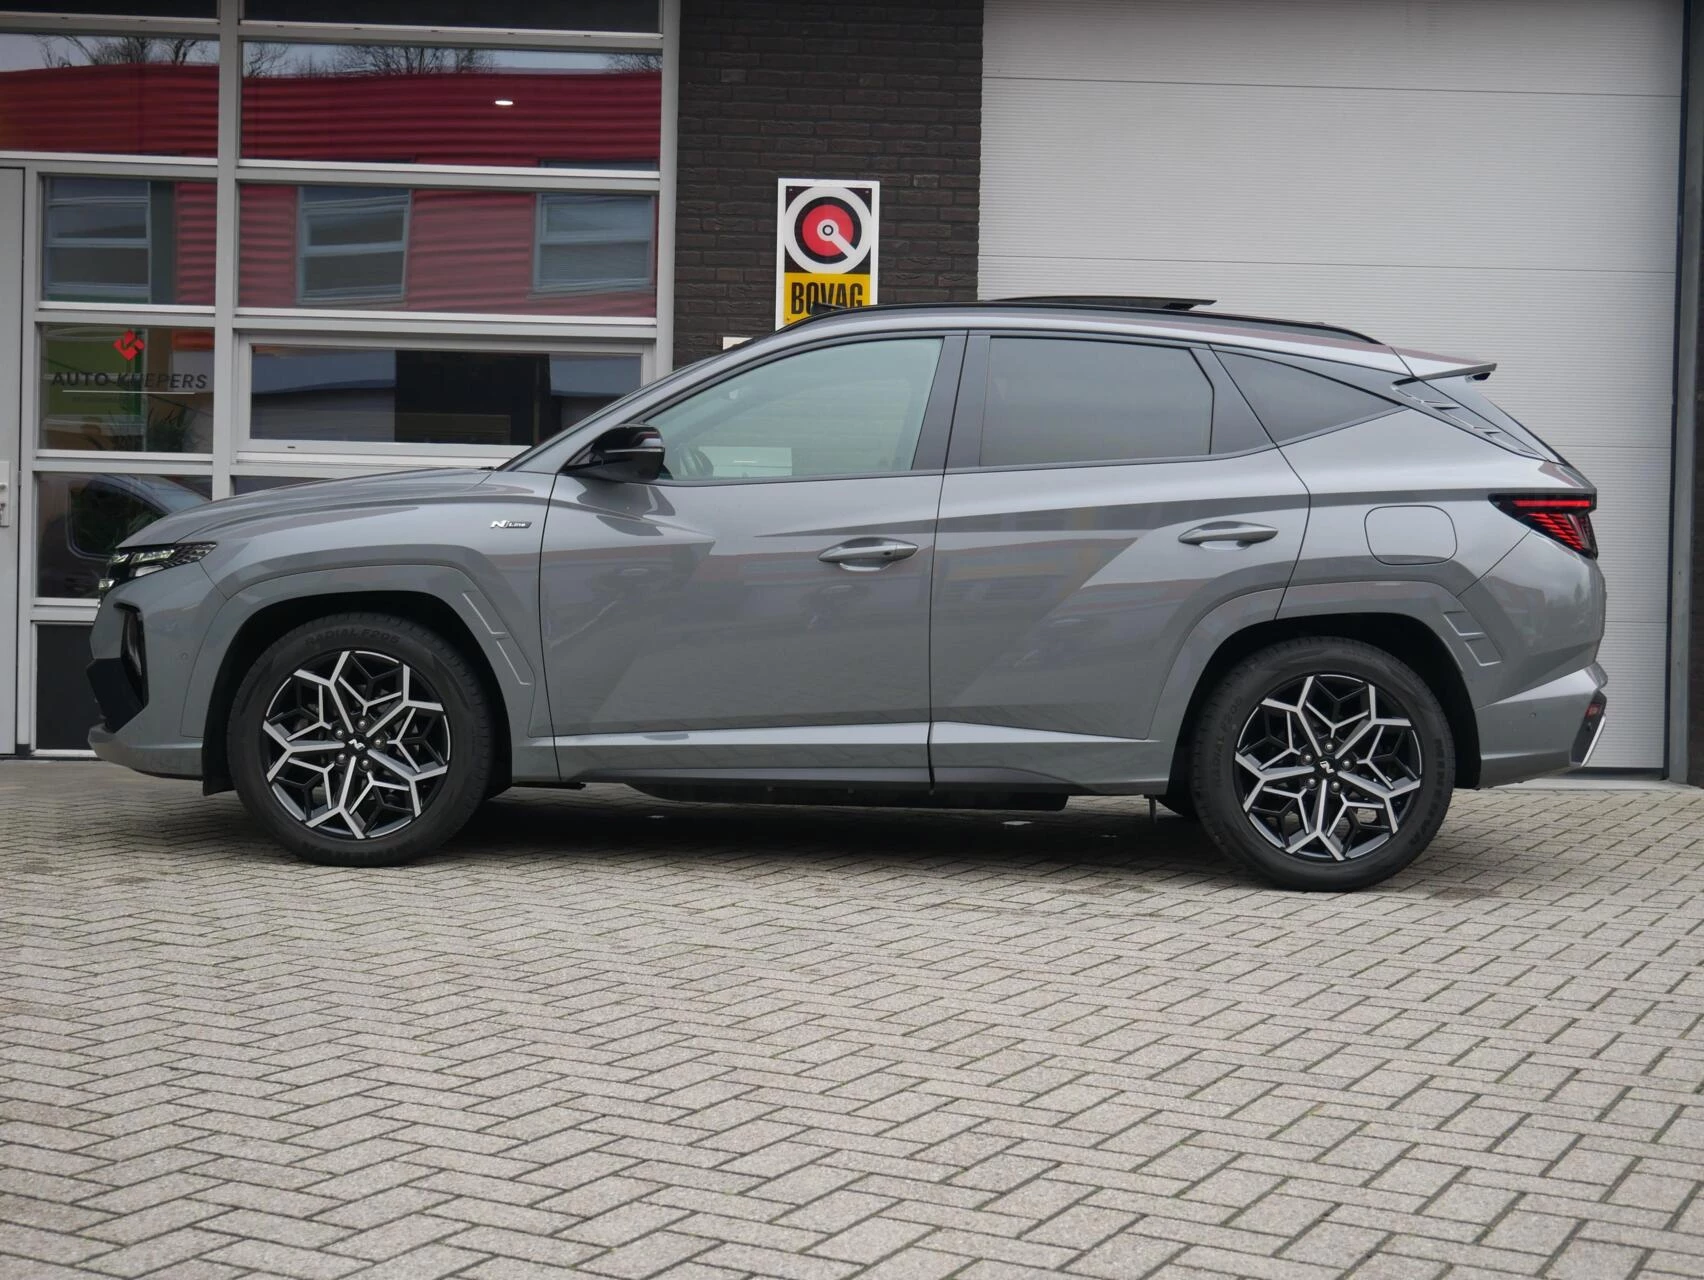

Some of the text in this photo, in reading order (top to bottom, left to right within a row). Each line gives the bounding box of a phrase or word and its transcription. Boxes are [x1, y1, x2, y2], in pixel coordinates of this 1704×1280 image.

[791, 281, 863, 315] BOVAG
[51, 371, 109, 387] AUTO
[489, 520, 508, 528] N
